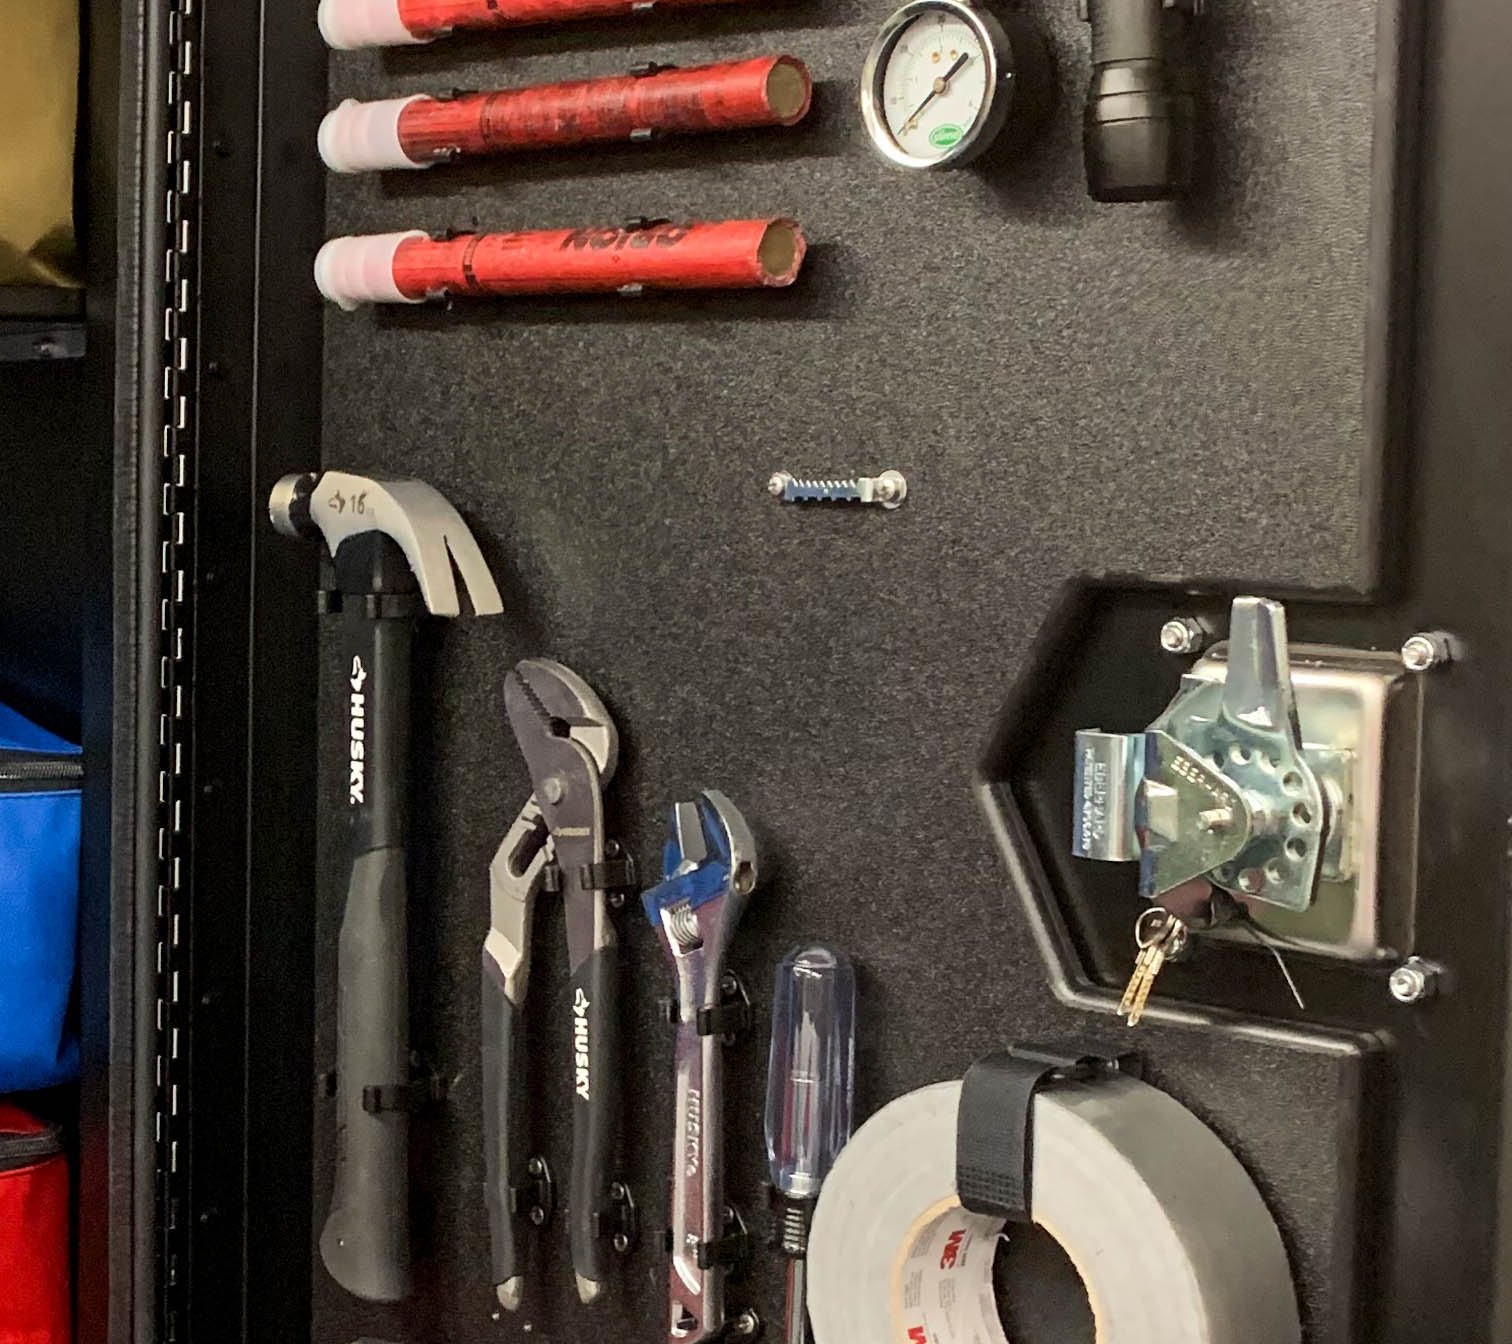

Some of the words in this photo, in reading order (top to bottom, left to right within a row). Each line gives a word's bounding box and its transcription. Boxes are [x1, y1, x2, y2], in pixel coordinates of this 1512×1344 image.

[351, 492, 367, 514] 16
[350, 692, 365, 804] HUSKY
[574, 1017, 590, 1100] HUSKY
[940, 1229, 967, 1270] 3M
